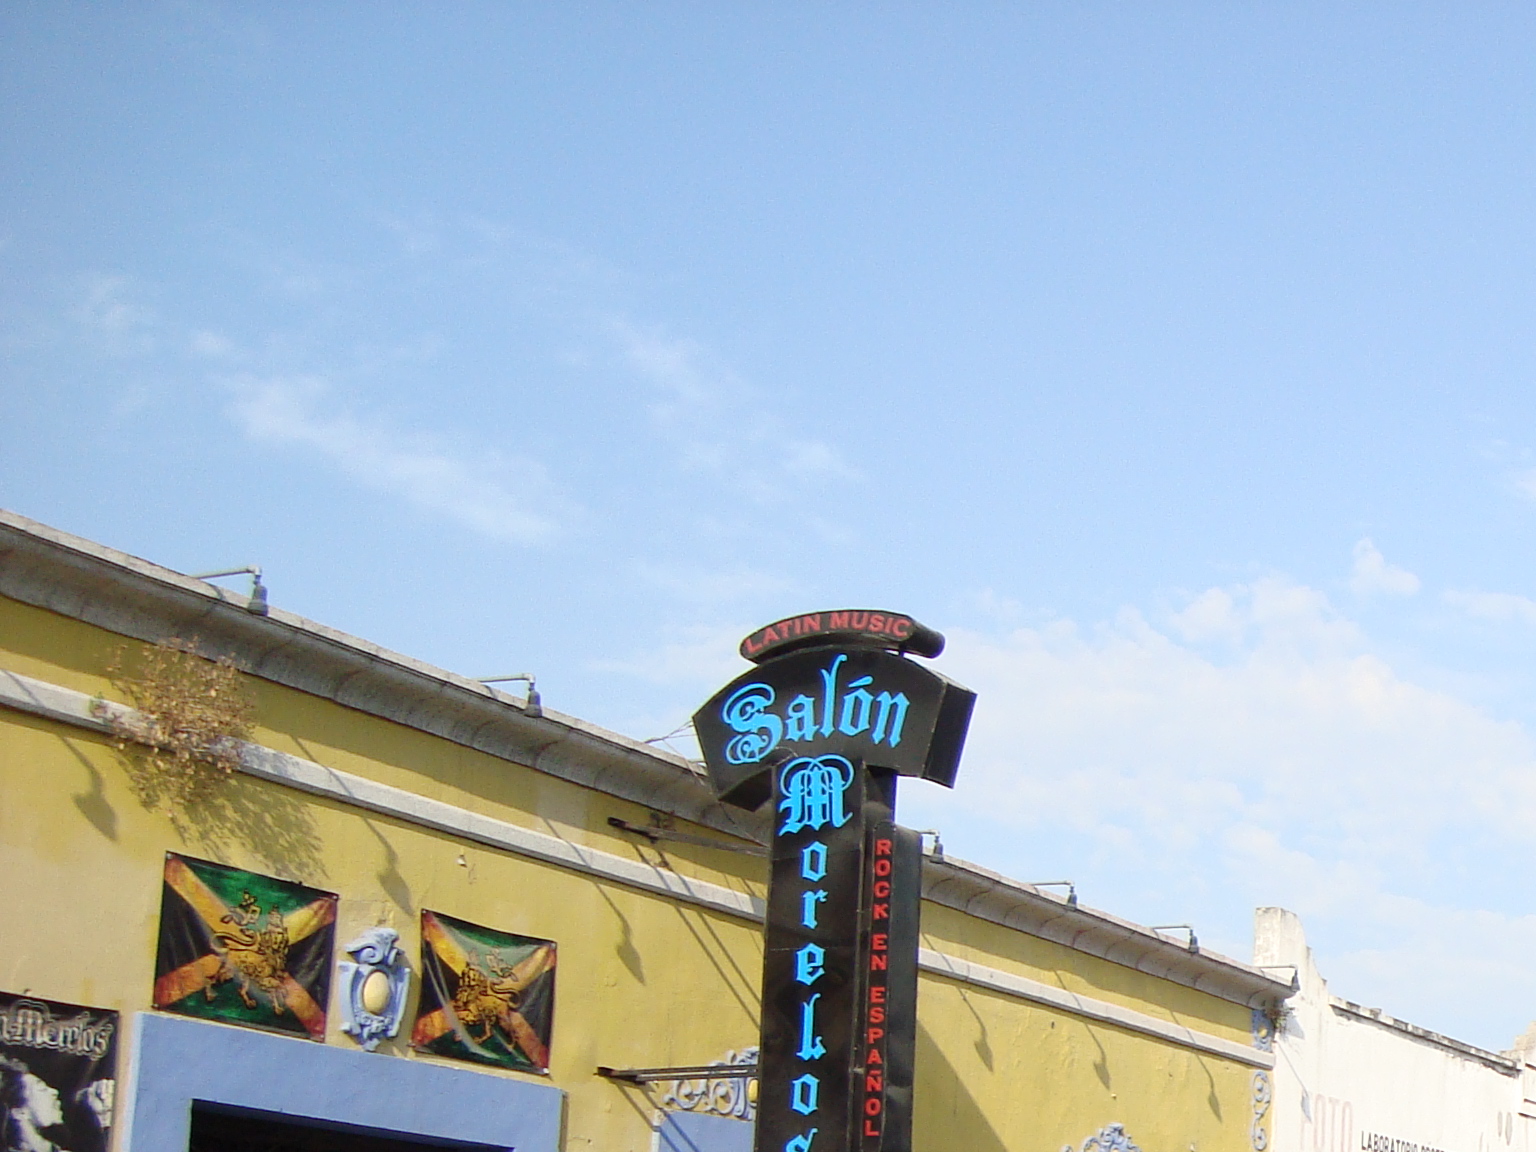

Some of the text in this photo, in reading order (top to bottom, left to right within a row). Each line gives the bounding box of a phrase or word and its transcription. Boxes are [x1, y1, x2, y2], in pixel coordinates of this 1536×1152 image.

[744, 611, 913, 653] LATIN MUSIC
[722, 654, 910, 764] Salón
[865, 838, 892, 1137] ROCK EN ESPAÑOL
